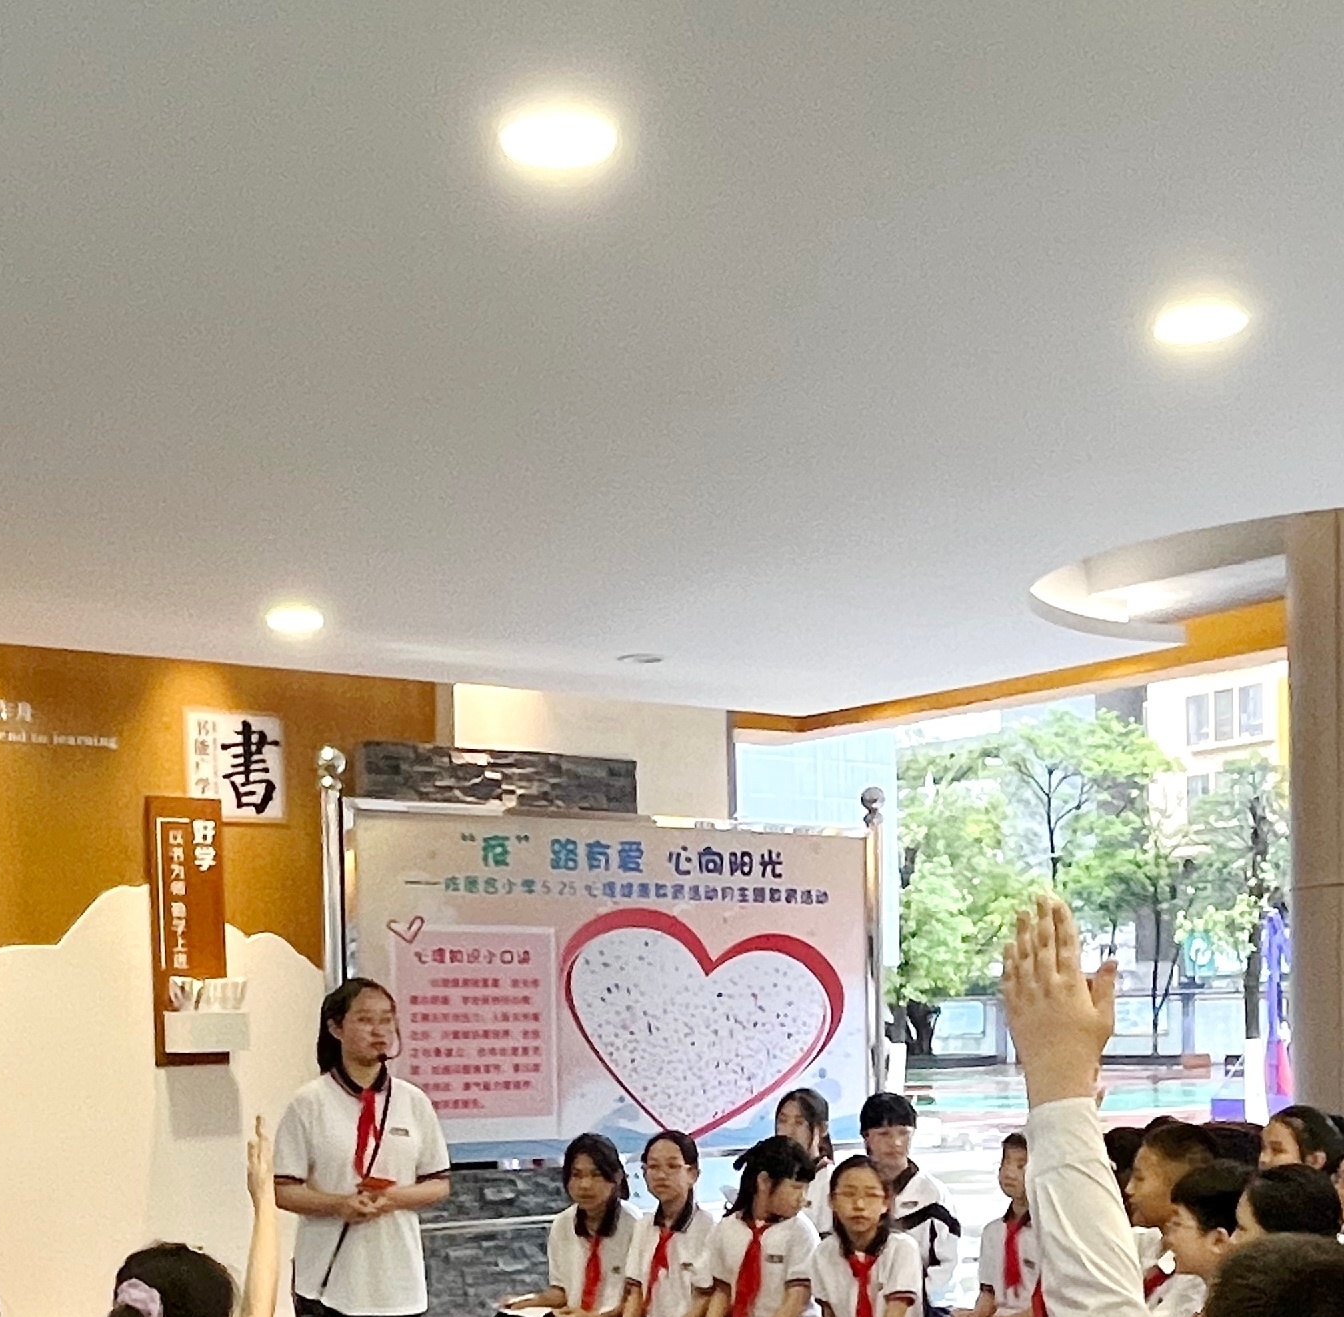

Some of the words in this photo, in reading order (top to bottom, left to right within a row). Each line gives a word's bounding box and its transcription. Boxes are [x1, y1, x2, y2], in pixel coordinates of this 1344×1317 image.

[32, 733, 49, 744] to
[52, 731, 119, 750] learning
[192, 819, 217, 872] 好学
[667, 845, 784, 880] 心向阳光
